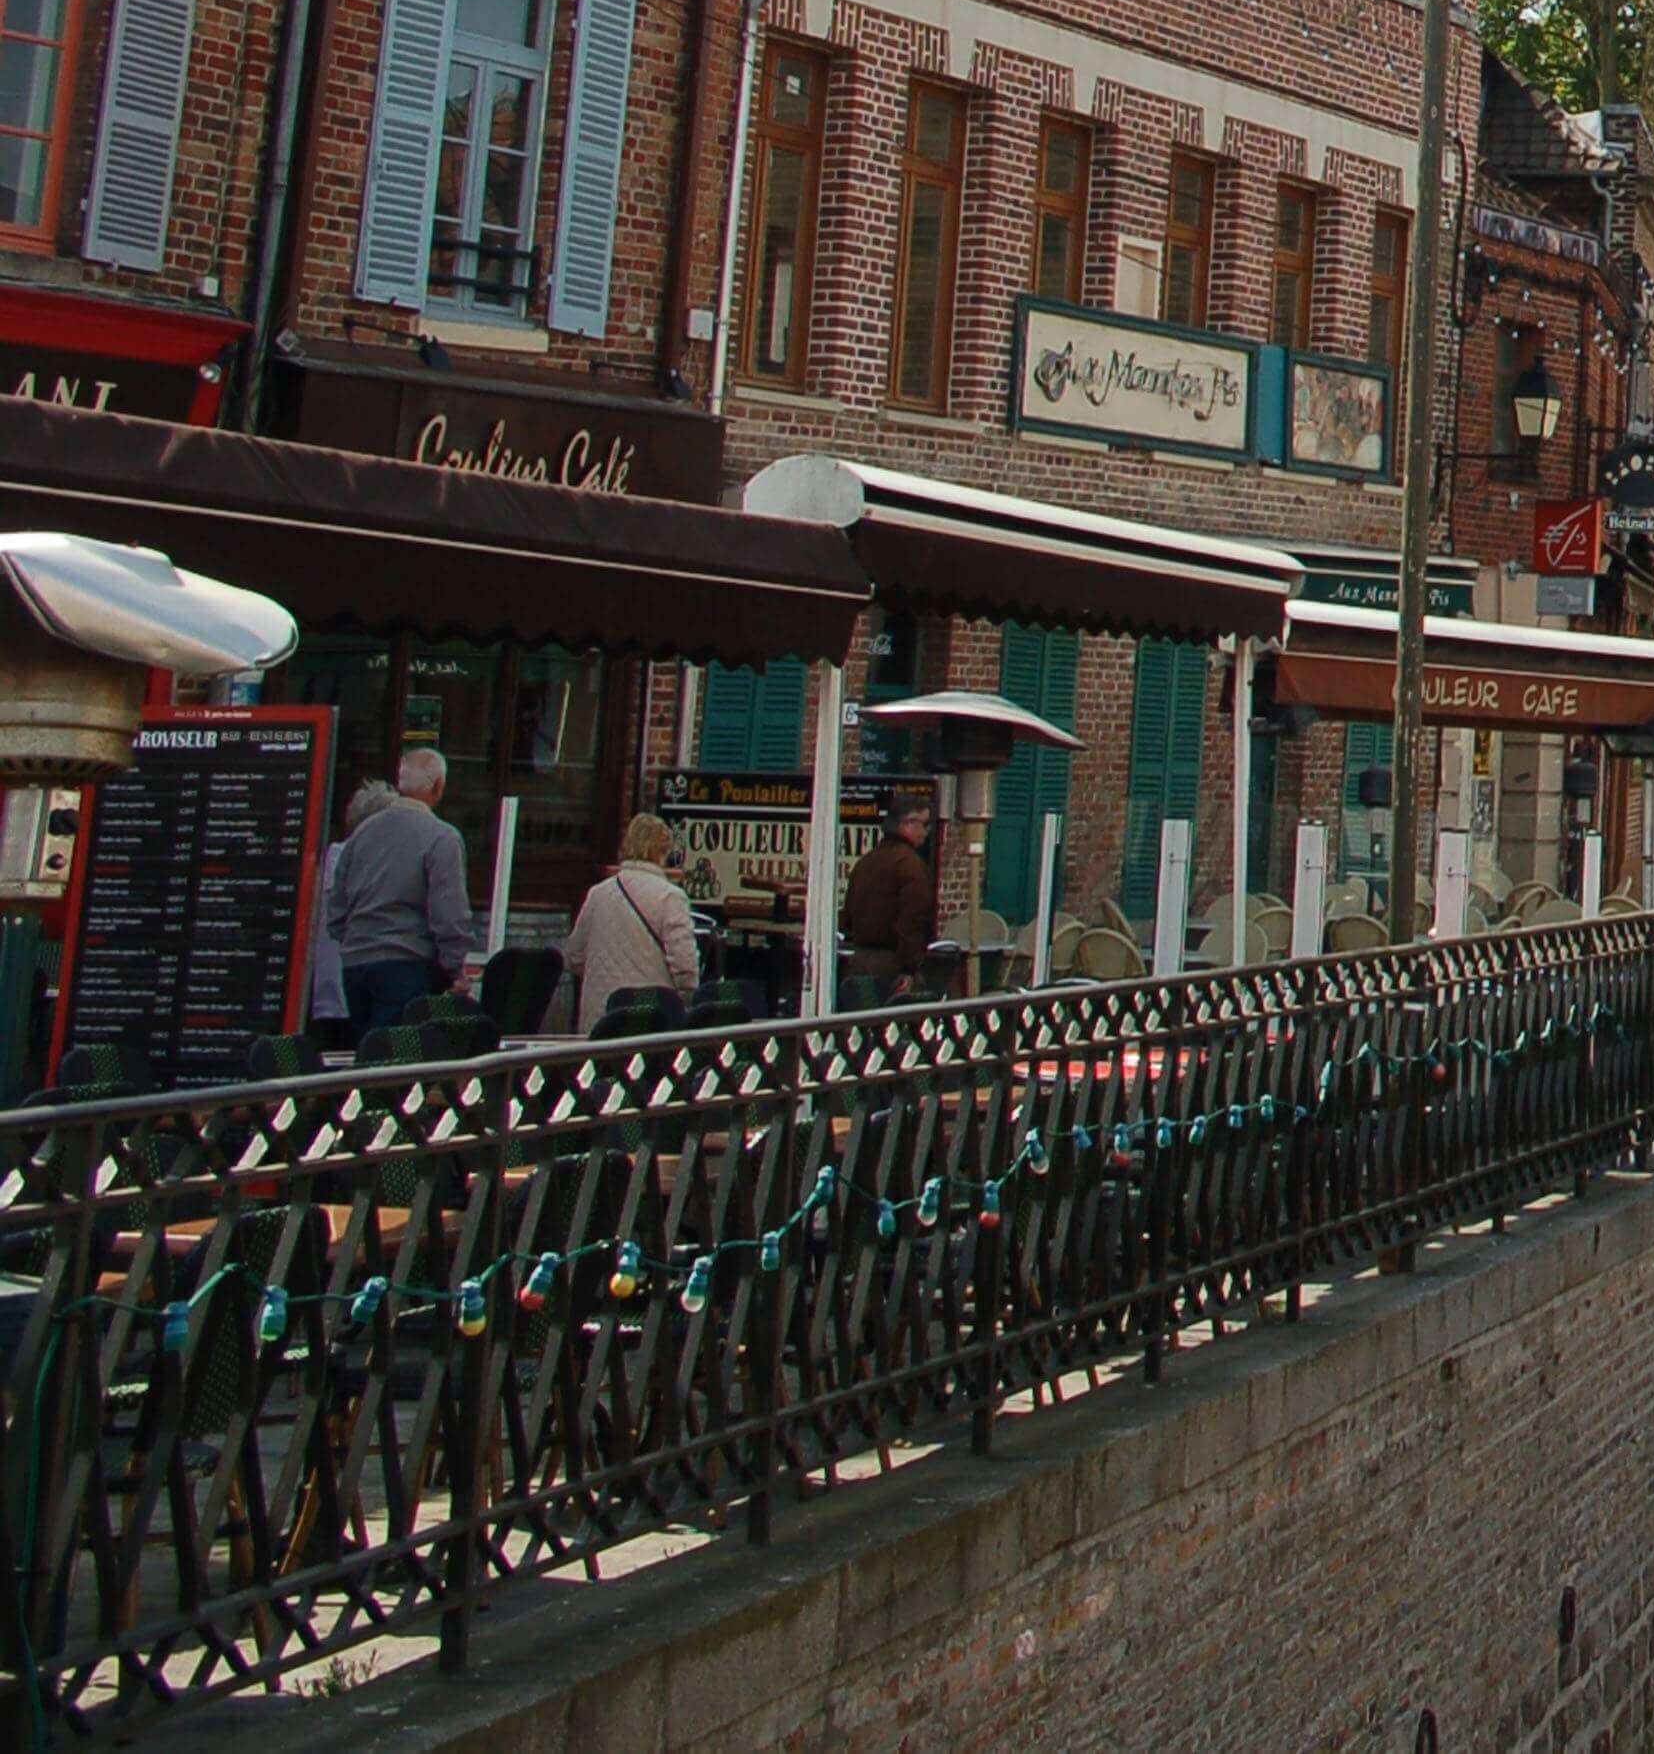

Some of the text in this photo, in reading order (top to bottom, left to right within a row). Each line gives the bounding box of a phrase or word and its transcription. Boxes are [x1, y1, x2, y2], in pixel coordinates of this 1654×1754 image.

[1393, 676, 1579, 718] ULEUR CAFE
[688, 820, 806, 855] COULEUR
